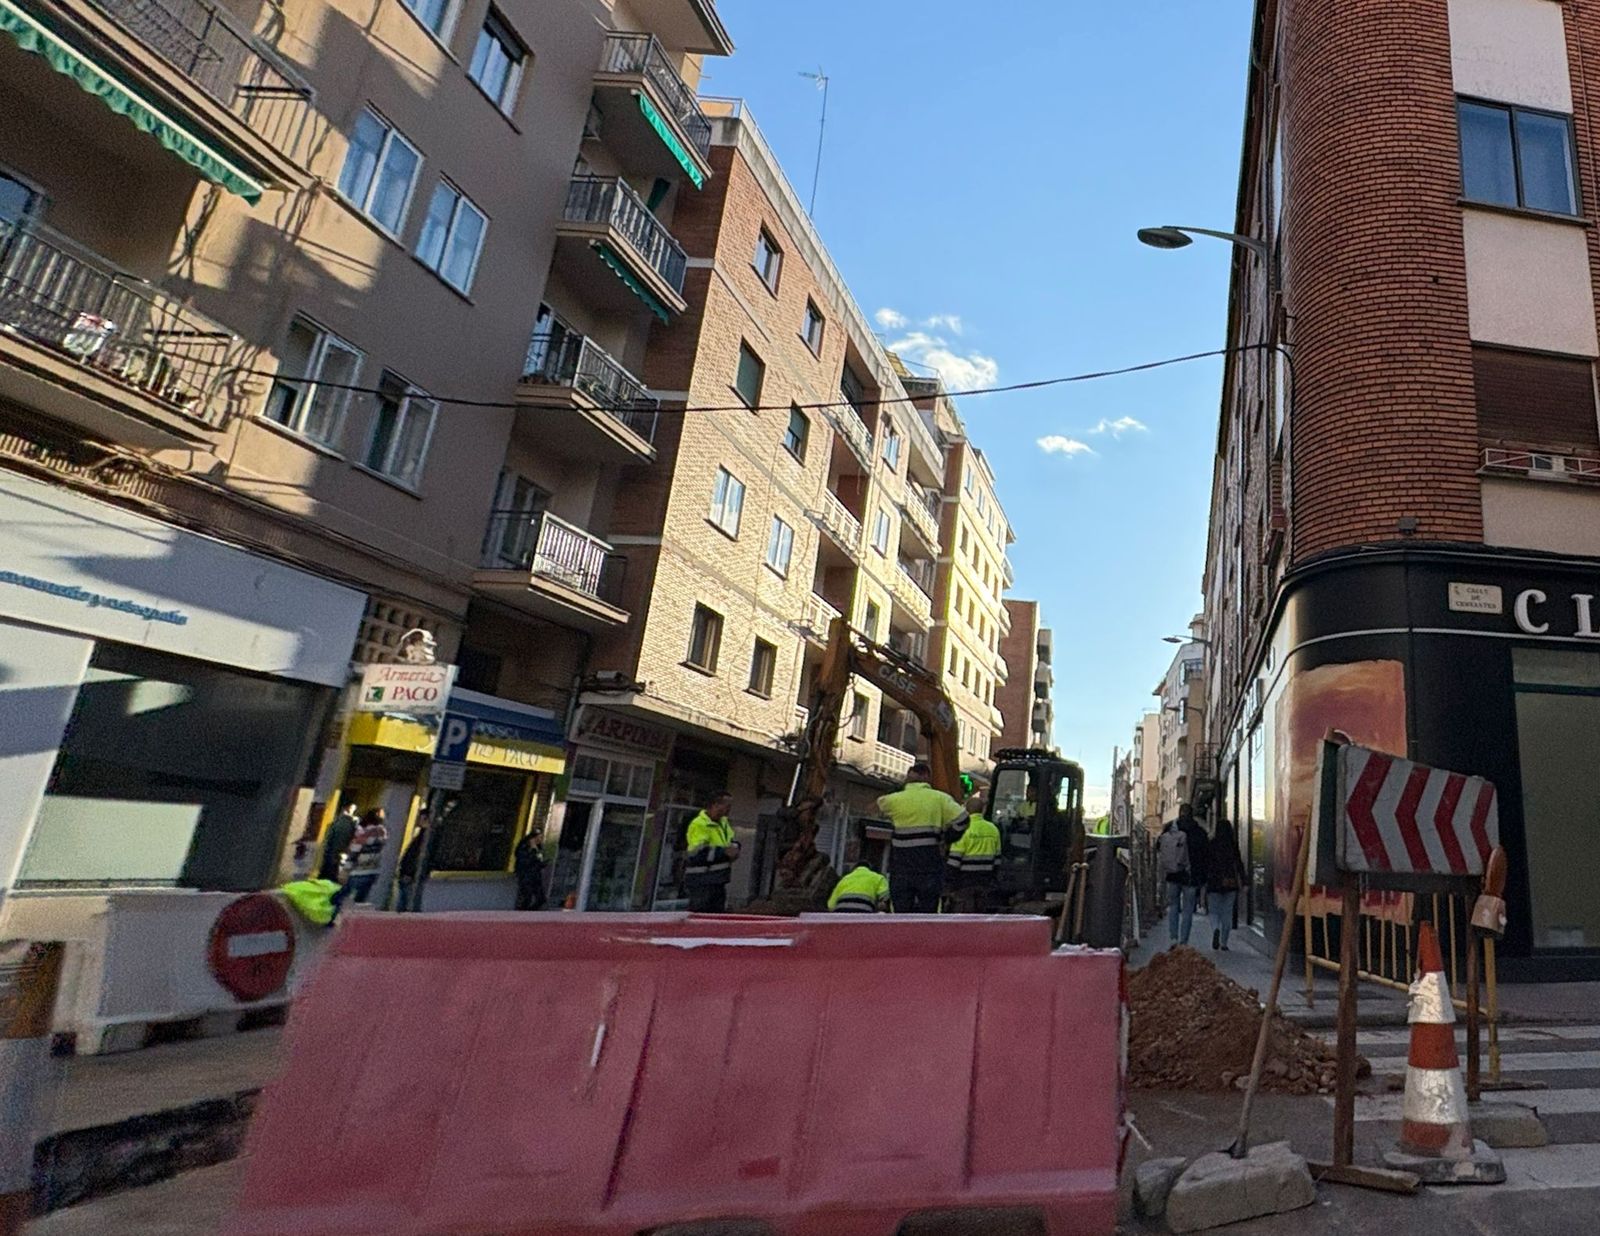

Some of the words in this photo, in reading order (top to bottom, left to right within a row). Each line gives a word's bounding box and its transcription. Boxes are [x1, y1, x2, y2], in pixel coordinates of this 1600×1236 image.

[392, 686, 438, 702] PACO
[879, 664, 918, 696] CASE
[442, 718, 468, 757] P
